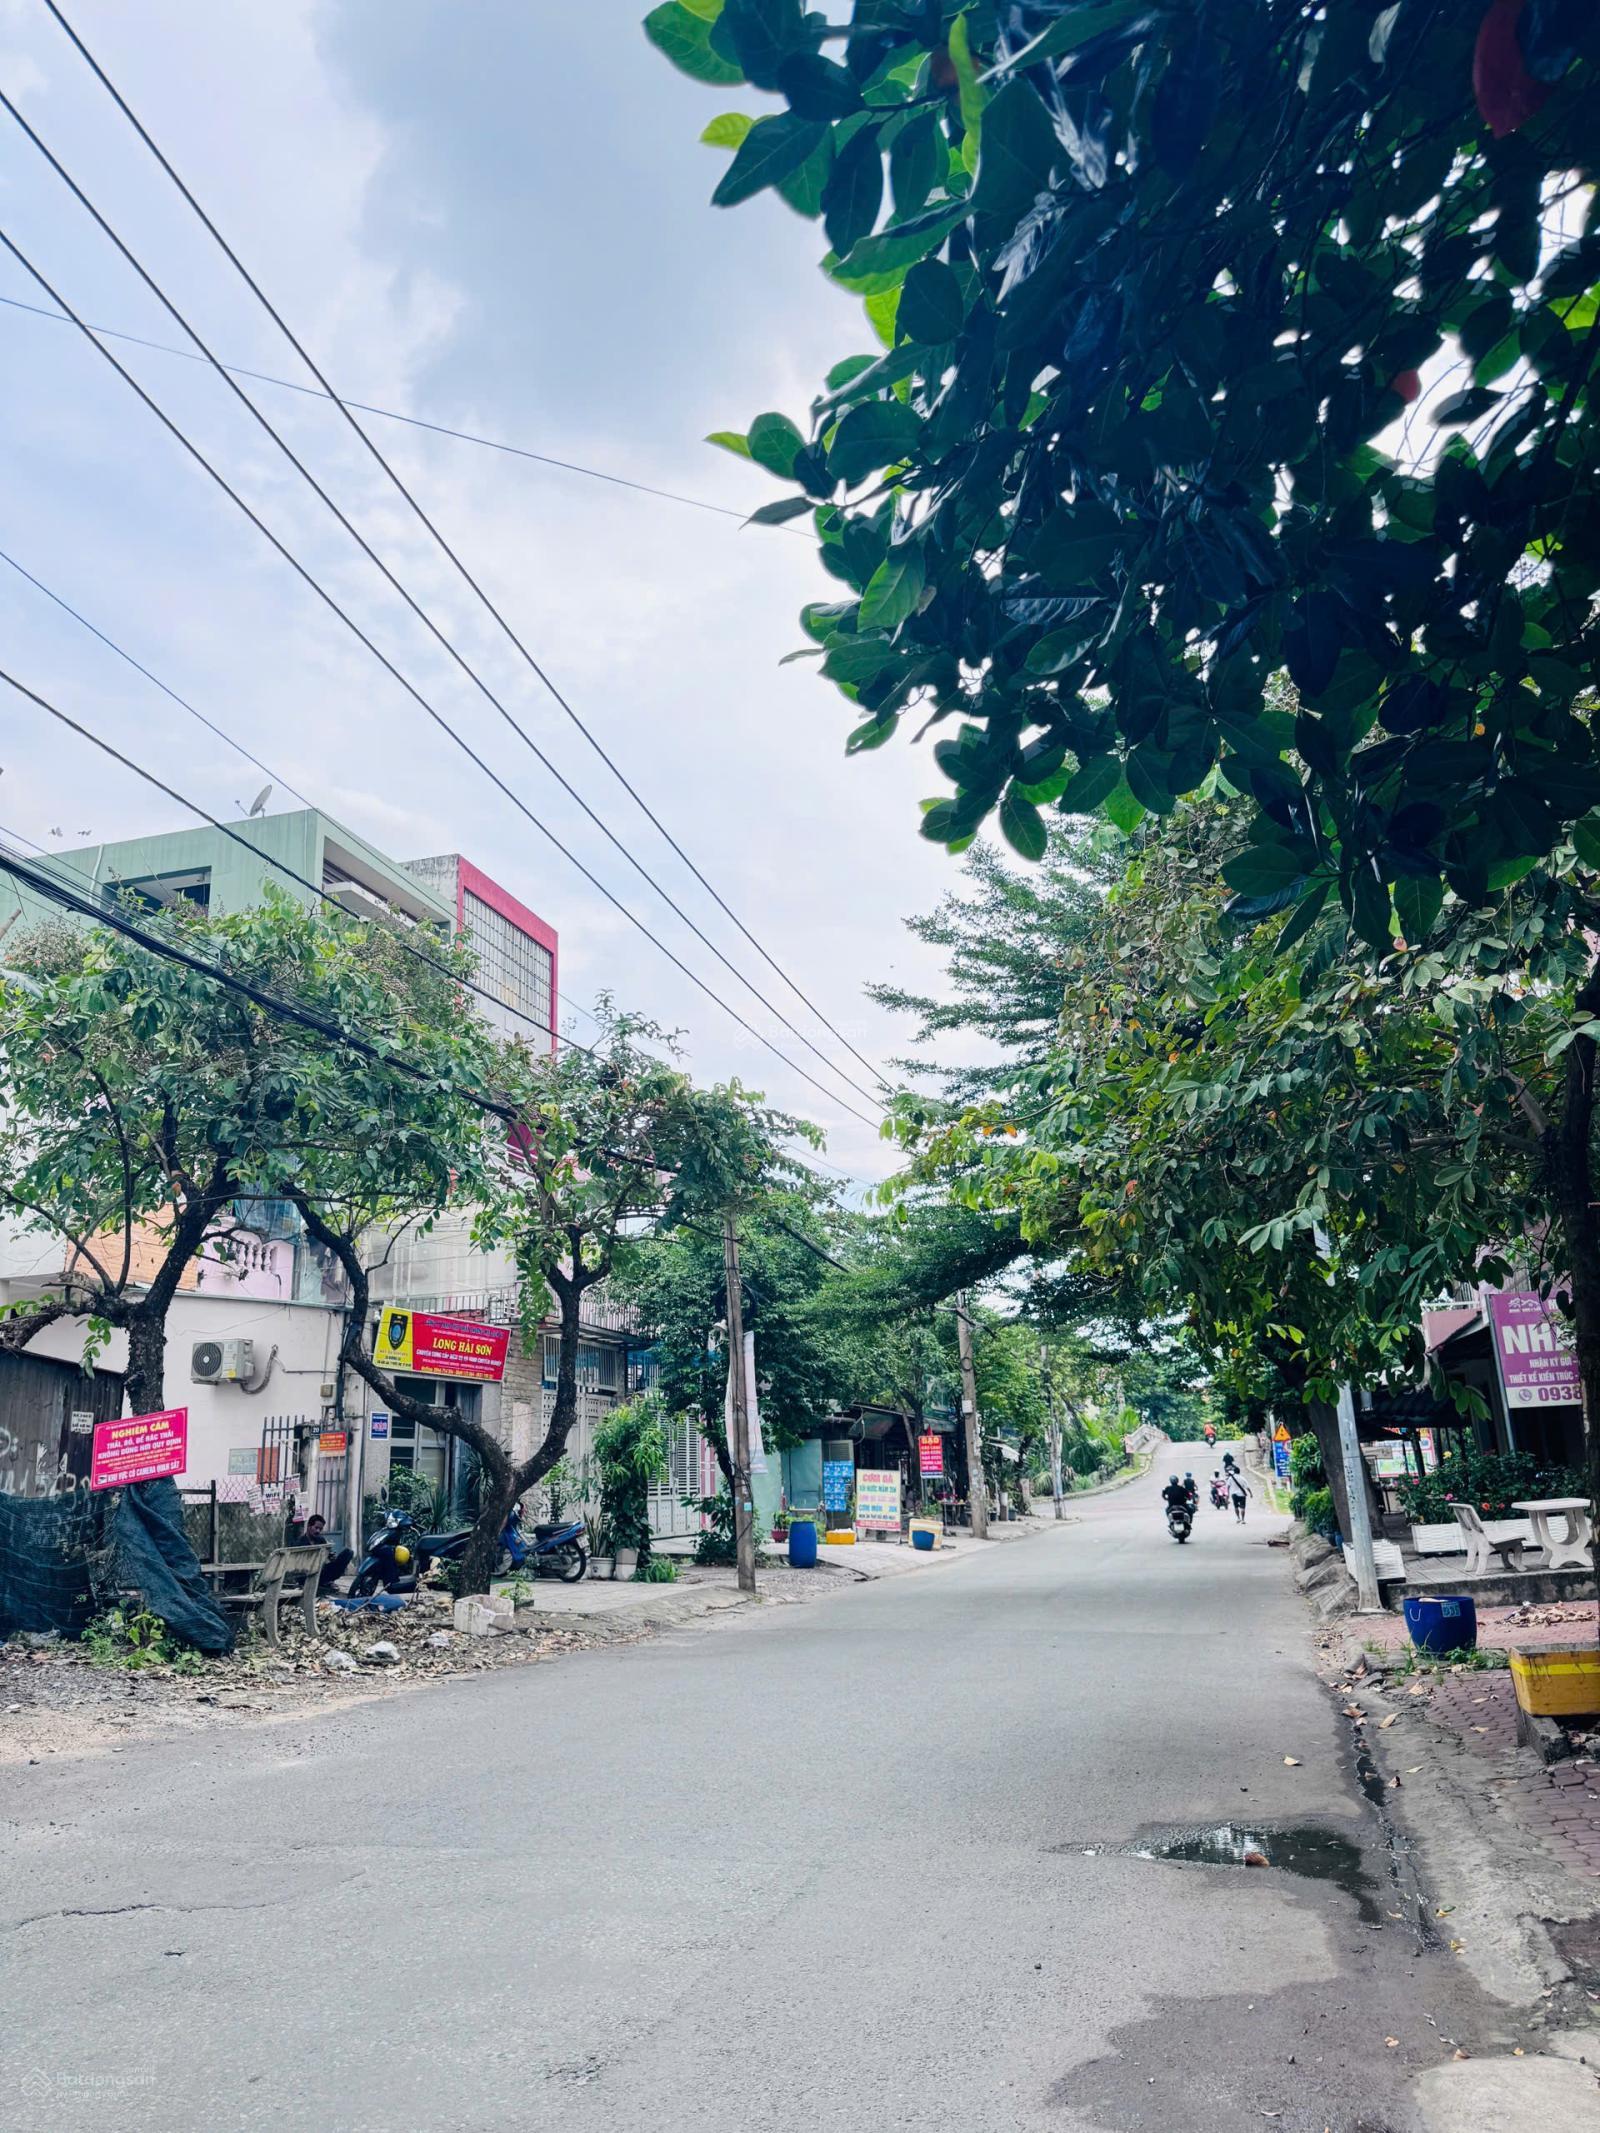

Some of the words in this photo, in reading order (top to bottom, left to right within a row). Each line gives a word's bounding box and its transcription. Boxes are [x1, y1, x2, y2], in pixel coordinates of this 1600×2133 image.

[433, 1337, 456, 1351] LONG
[458, 1339, 474, 1354] HẢI
[475, 1344, 493, 1355] SƠN
[1529, 1357, 1549, 1370] NHẬN
[1509, 1372, 1527, 1384] THIẾT
[1528, 1371, 1538, 1382] KẾ
[1538, 1371, 1555, 1382] KIẾN
[1556, 1371, 1574, 1381] TRÚC
[111, 1425, 148, 1440] NGHIÊM
[150, 1421, 170, 1431] CẤM
[152, 1441, 164, 1449] QUY
[136, 1465, 156, 1476] CAMERA
